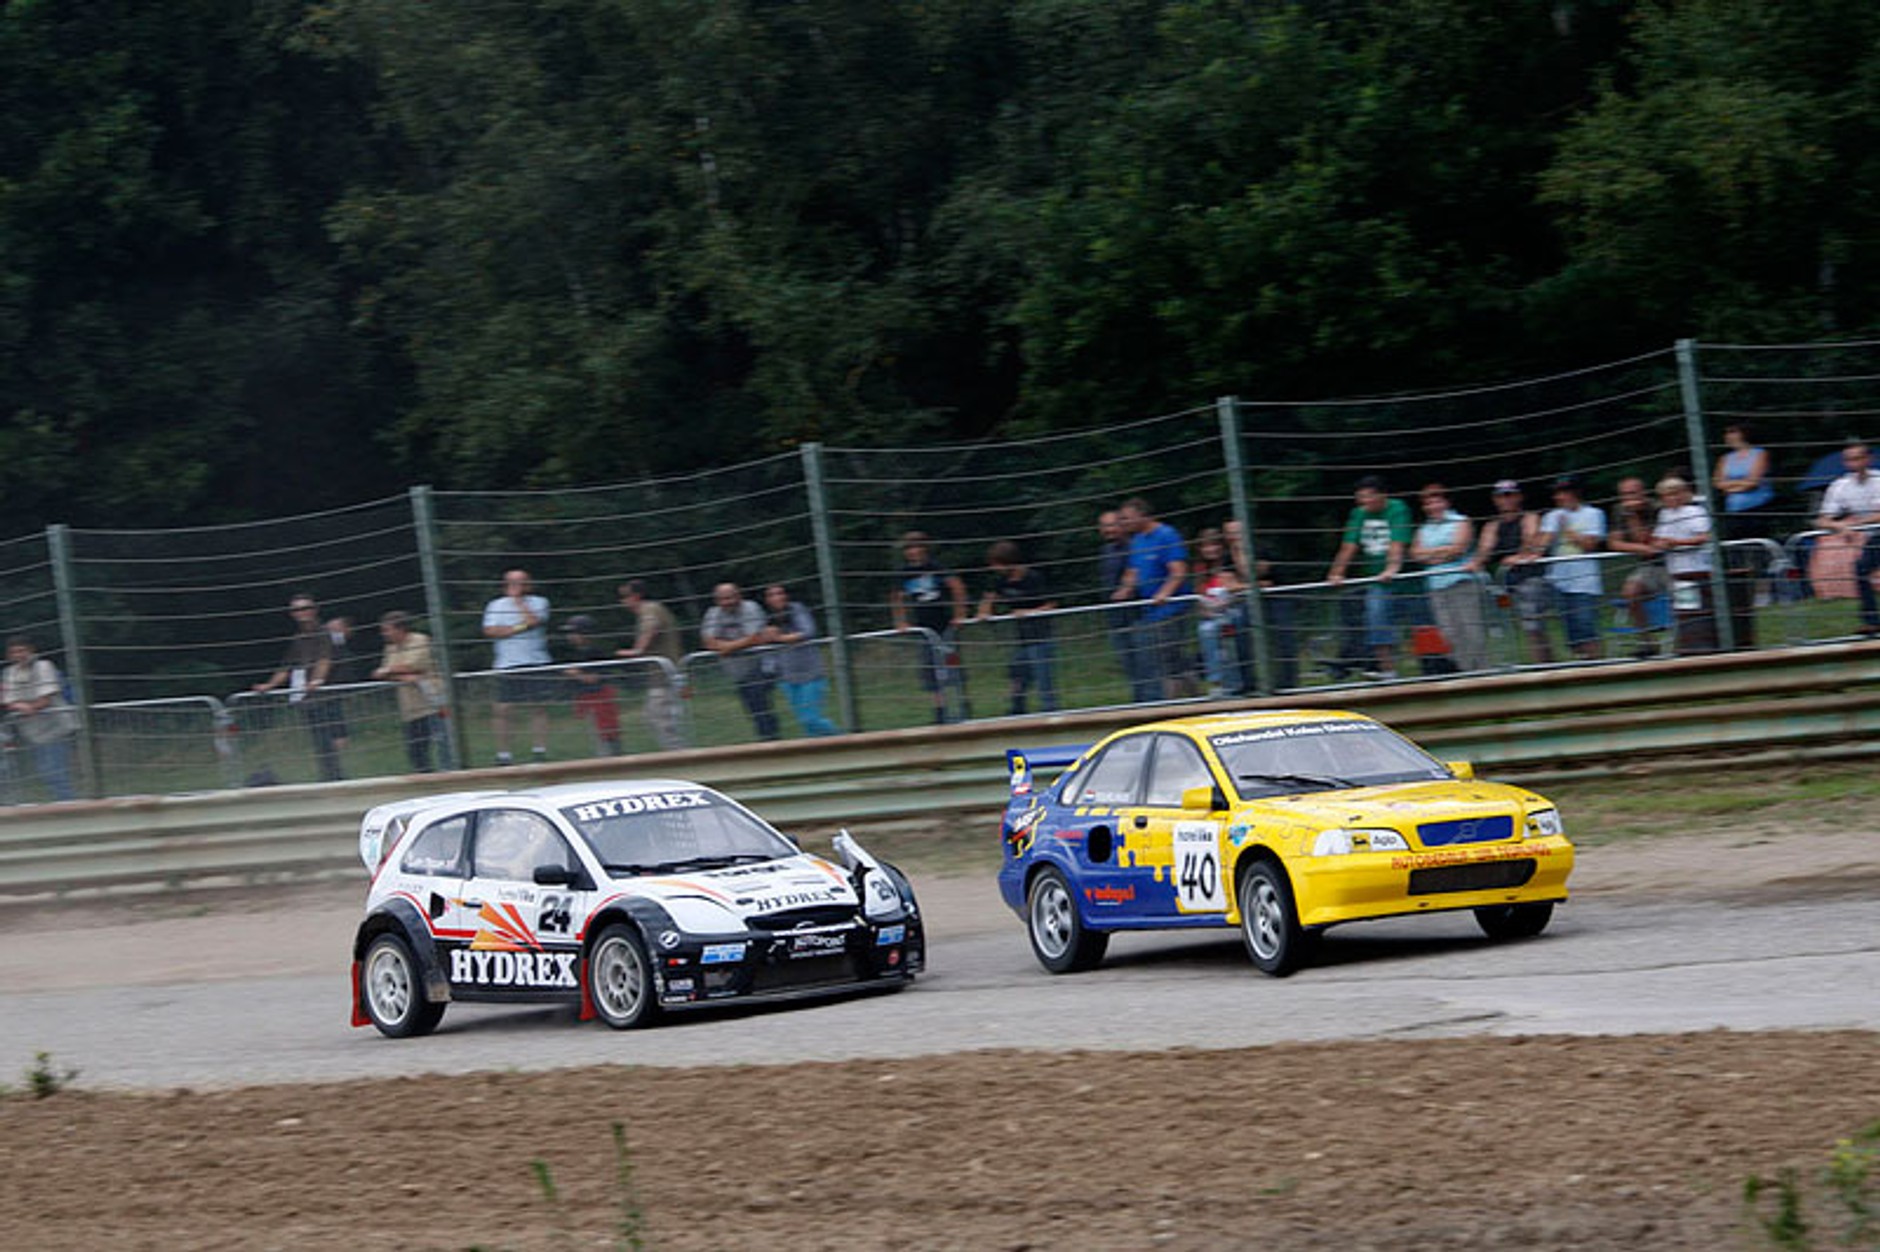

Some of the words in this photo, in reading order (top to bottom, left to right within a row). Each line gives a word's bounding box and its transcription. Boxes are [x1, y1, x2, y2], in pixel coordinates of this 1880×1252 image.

[574, 792, 712, 822] HYDREX
[1181, 852, 1216, 901] 40
[539, 895, 573, 933] 24
[757, 891, 838, 911] HYDREX
[450, 950, 578, 988] HYDREX
